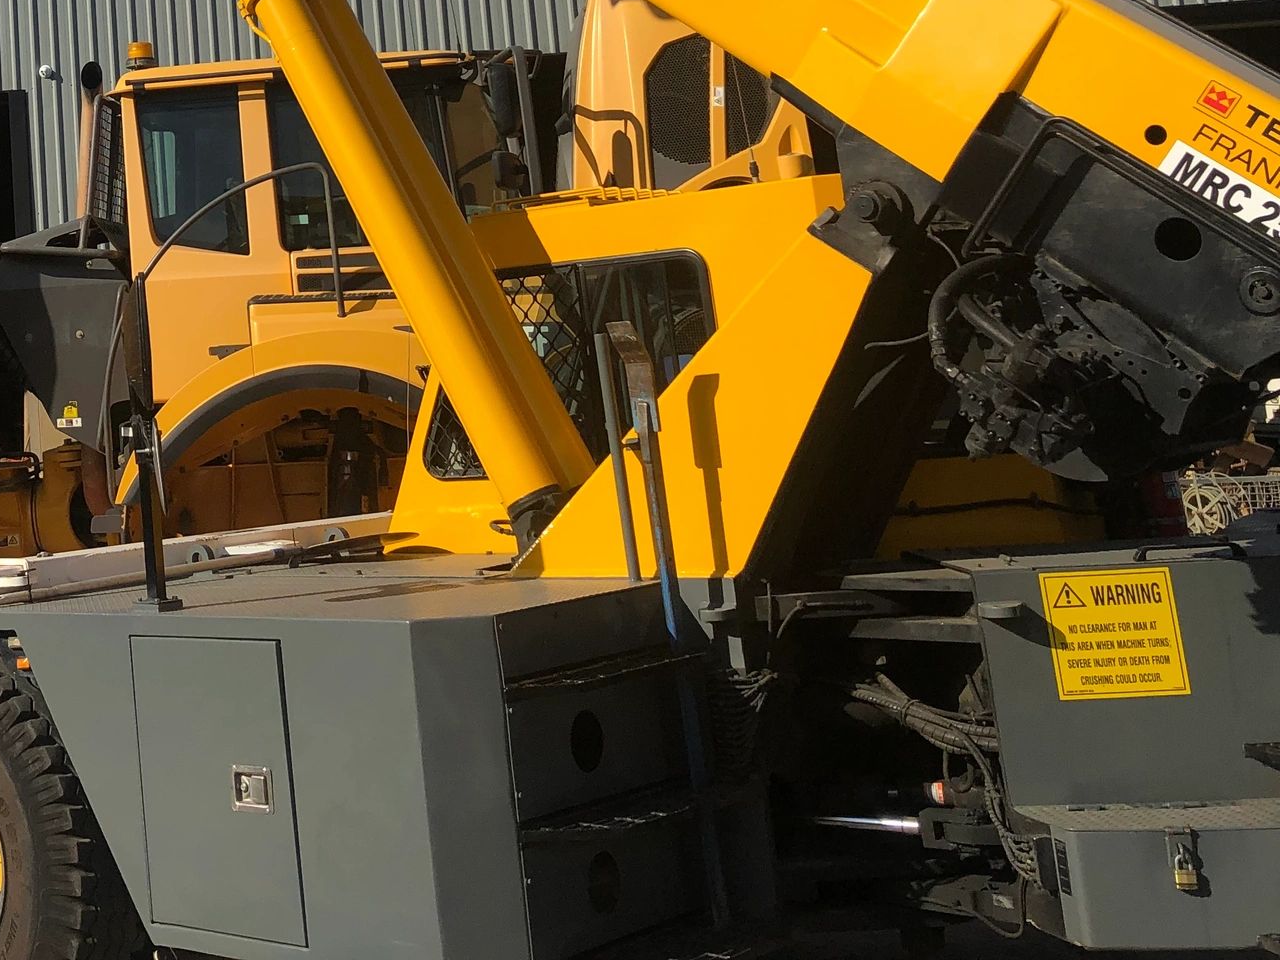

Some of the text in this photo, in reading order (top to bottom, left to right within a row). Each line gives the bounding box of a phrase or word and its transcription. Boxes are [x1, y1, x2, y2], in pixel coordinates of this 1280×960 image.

[1192, 123, 1280, 190] FRAN
[1170, 151, 1280, 239] MRC 2
[1090, 582, 1163, 606] WARNING
[1068, 621, 1157, 634] NO CLEARANCE FOR MAN AT
[1077, 641, 1094, 651] AREA
[1095, 640, 1115, 650] WHEN
[1116, 639, 1146, 649] MACHINE
[1067, 655, 1171, 669] SEVERE INJURY OR DEATH FROM
[1080, 674, 1114, 686] CRUSHING
[1115, 673, 1138, 684] COULD
